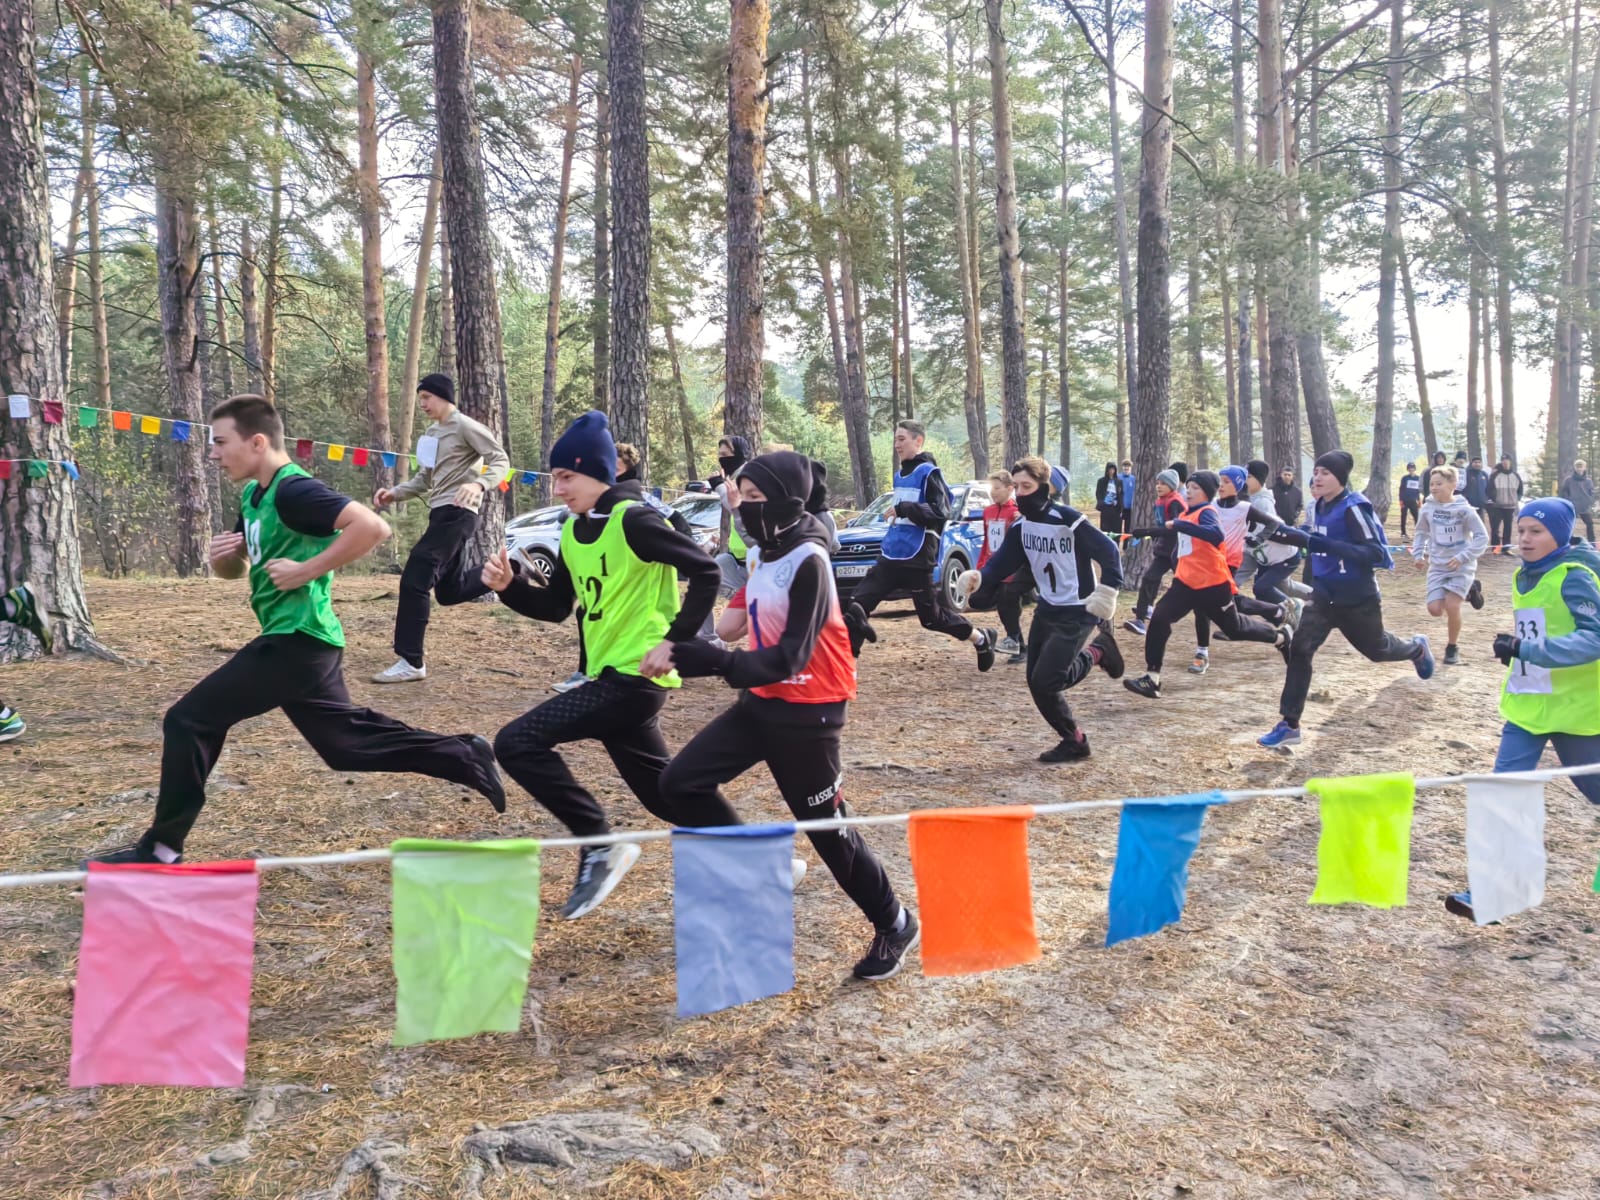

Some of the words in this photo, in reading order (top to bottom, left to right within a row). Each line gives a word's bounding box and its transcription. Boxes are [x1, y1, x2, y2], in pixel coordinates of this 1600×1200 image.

[1023, 533, 1058, 554] ШКОЛА
[1060, 537, 1072, 554] 60
[599, 552, 609, 577] 1
[1339, 559, 1347, 574] 1
[1043, 562, 1057, 594] 1
[749, 598, 763, 651] 1
[807, 785, 835, 807] CLASSIC
